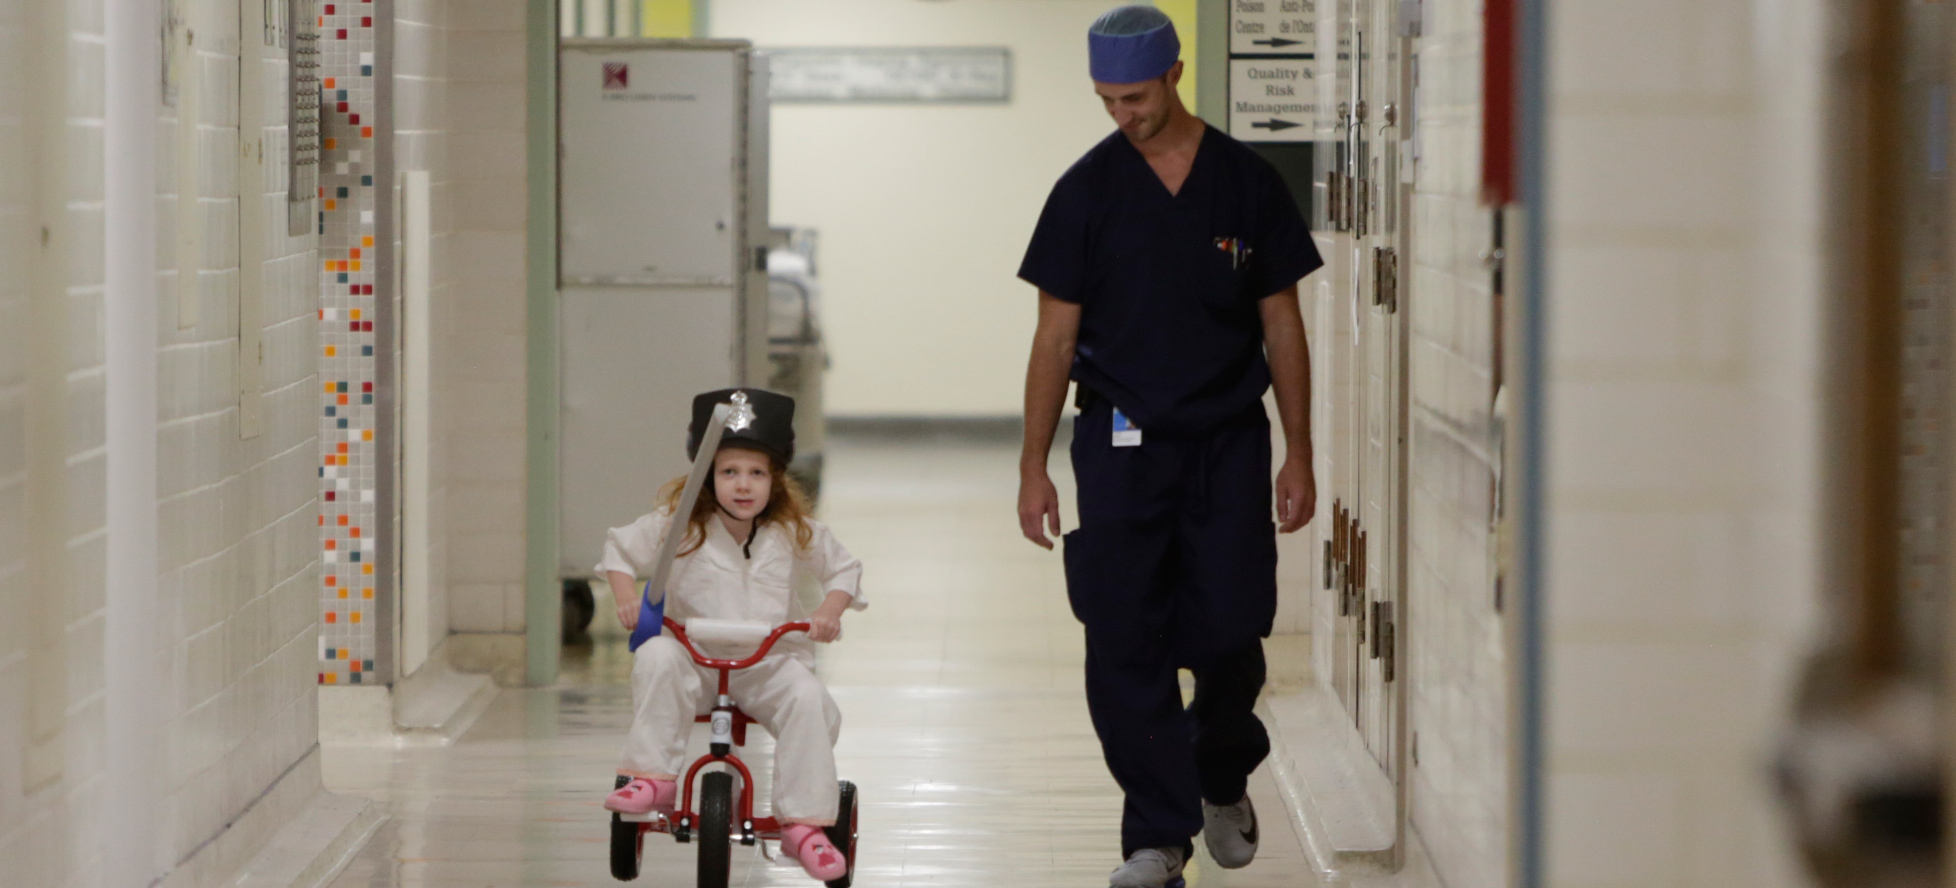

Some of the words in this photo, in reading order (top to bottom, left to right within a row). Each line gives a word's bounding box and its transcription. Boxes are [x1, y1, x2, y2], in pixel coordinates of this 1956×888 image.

[1236, 0, 1265, 12] Poison
[1235, 20, 1265, 33] Centre
[1279, 19, 1290, 33] de
[1247, 68, 1298, 80] Quality
[1303, 67, 1313, 79] &
[1265, 84, 1295, 96] Risk
